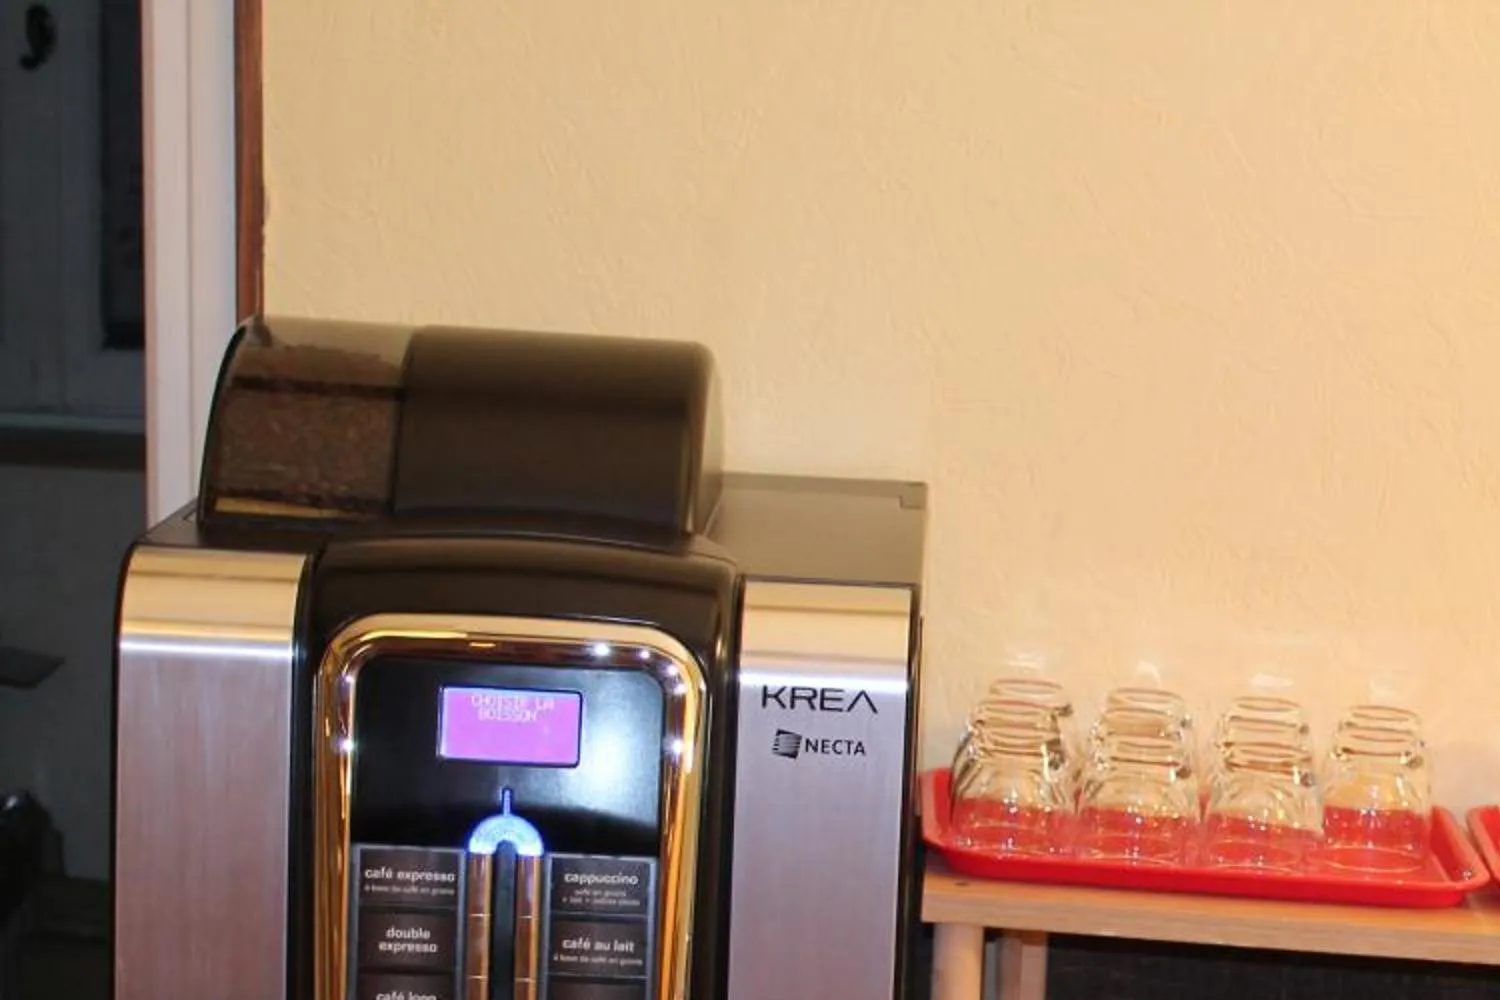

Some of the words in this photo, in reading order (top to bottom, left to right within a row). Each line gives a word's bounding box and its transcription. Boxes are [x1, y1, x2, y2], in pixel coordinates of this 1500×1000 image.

[762, 685, 878, 714] KREA
[805, 738, 866, 756] NECTA
[364, 866, 393, 879] café
[397, 869, 455, 882] expresso
[564, 872, 639, 886] cappuccino
[385, 926, 431, 939] double
[378, 940, 438, 953] expresso
[562, 936, 591, 949] café
[594, 940, 610, 951] au
[613, 939, 635, 952] lait
